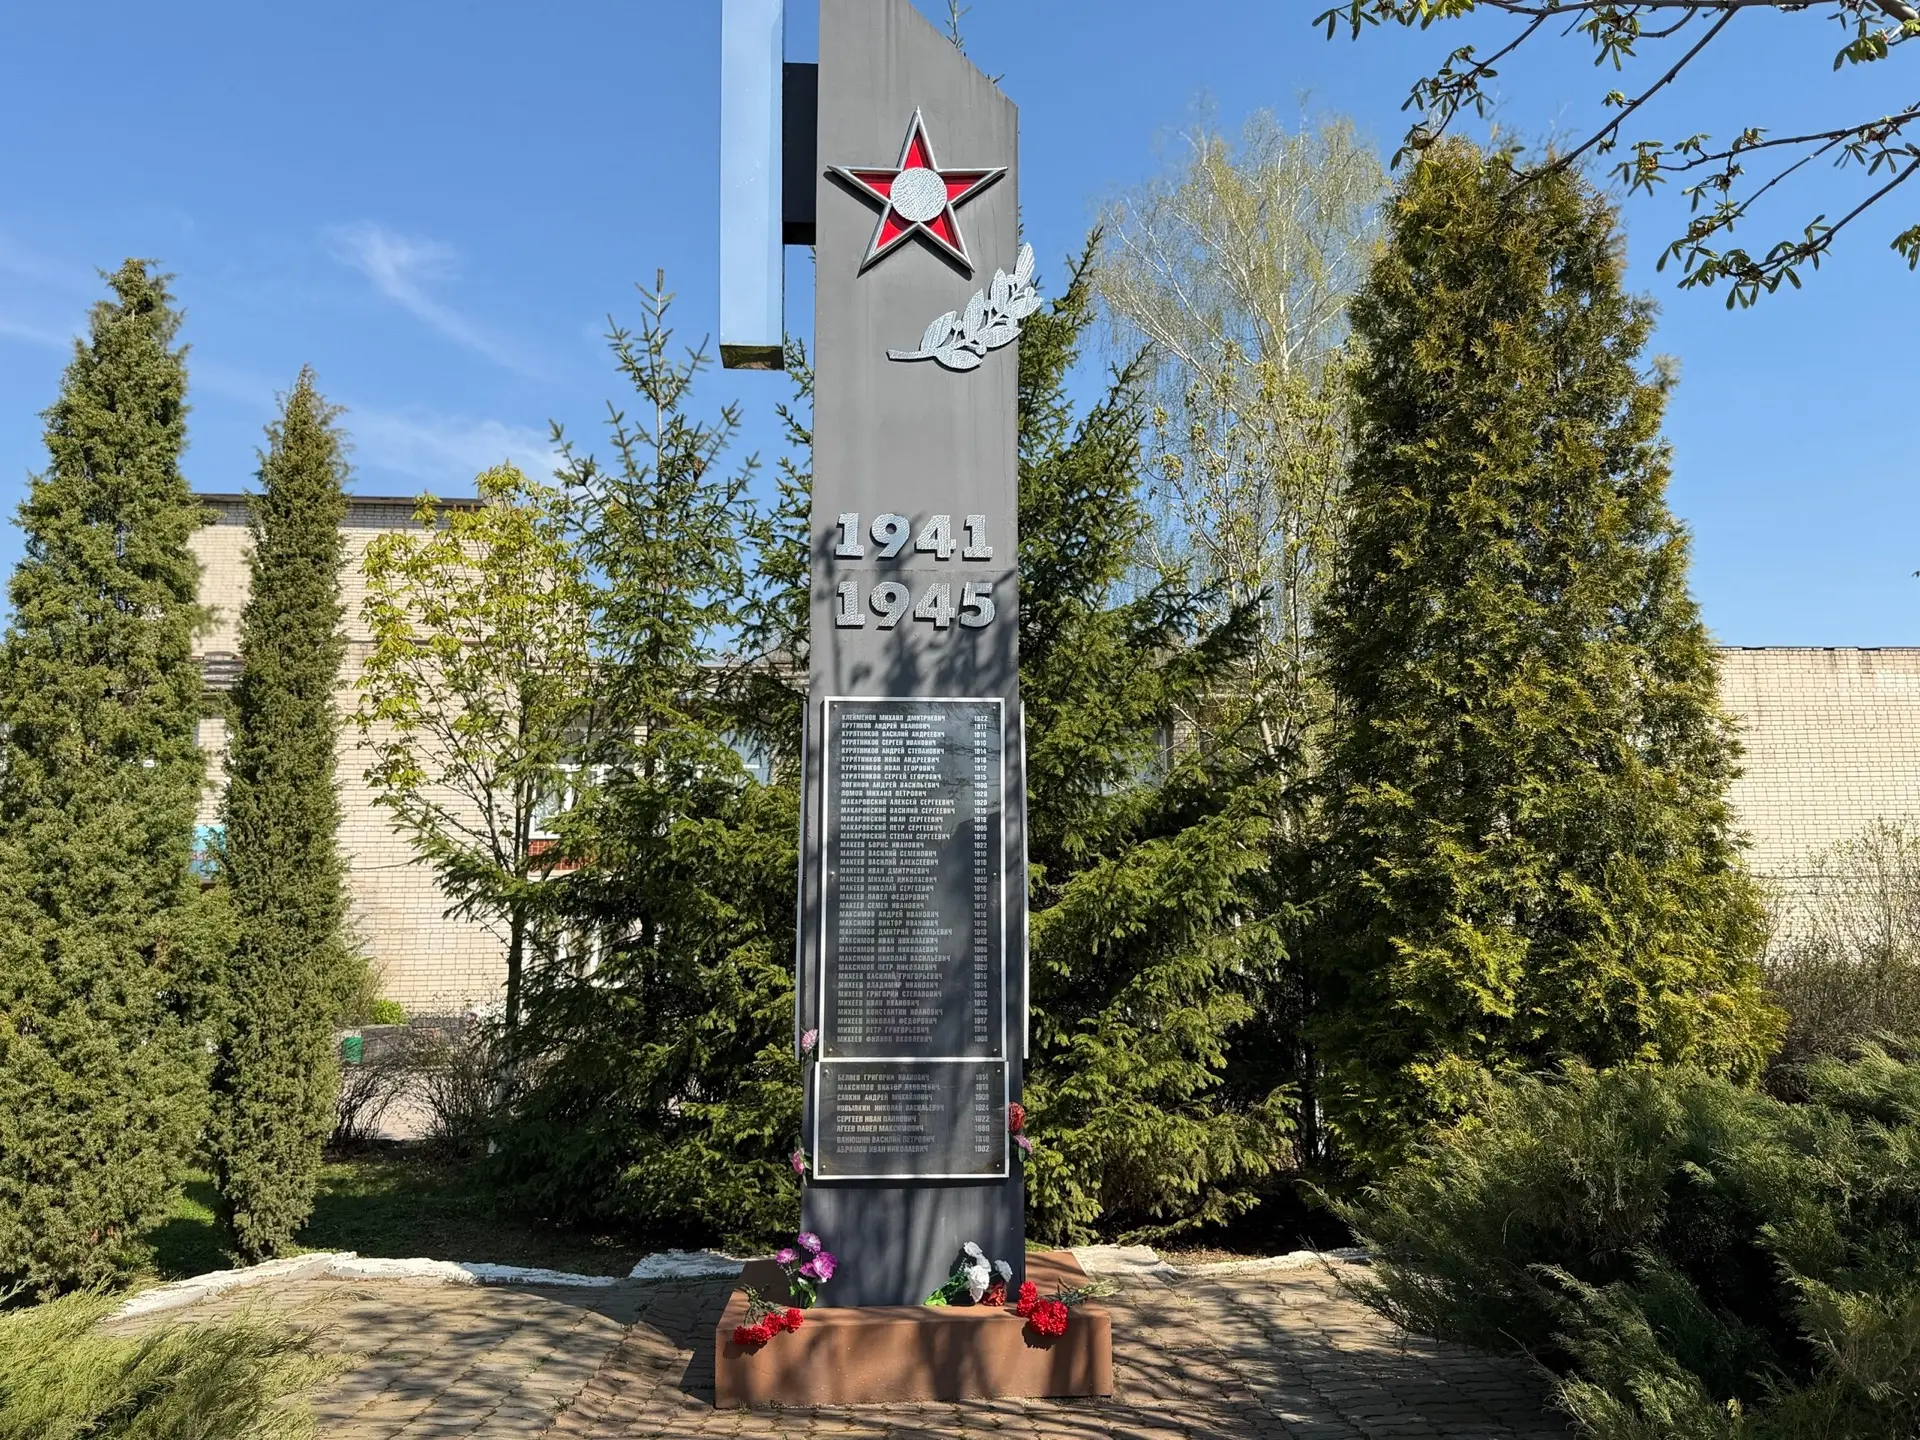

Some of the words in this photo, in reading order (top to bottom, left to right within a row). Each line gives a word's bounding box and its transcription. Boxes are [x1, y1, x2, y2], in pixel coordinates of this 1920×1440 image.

[835, 512, 994, 560] 1941
[836, 581, 996, 628] 1945
[878, 910, 903, 918] АНДРЕЙ
